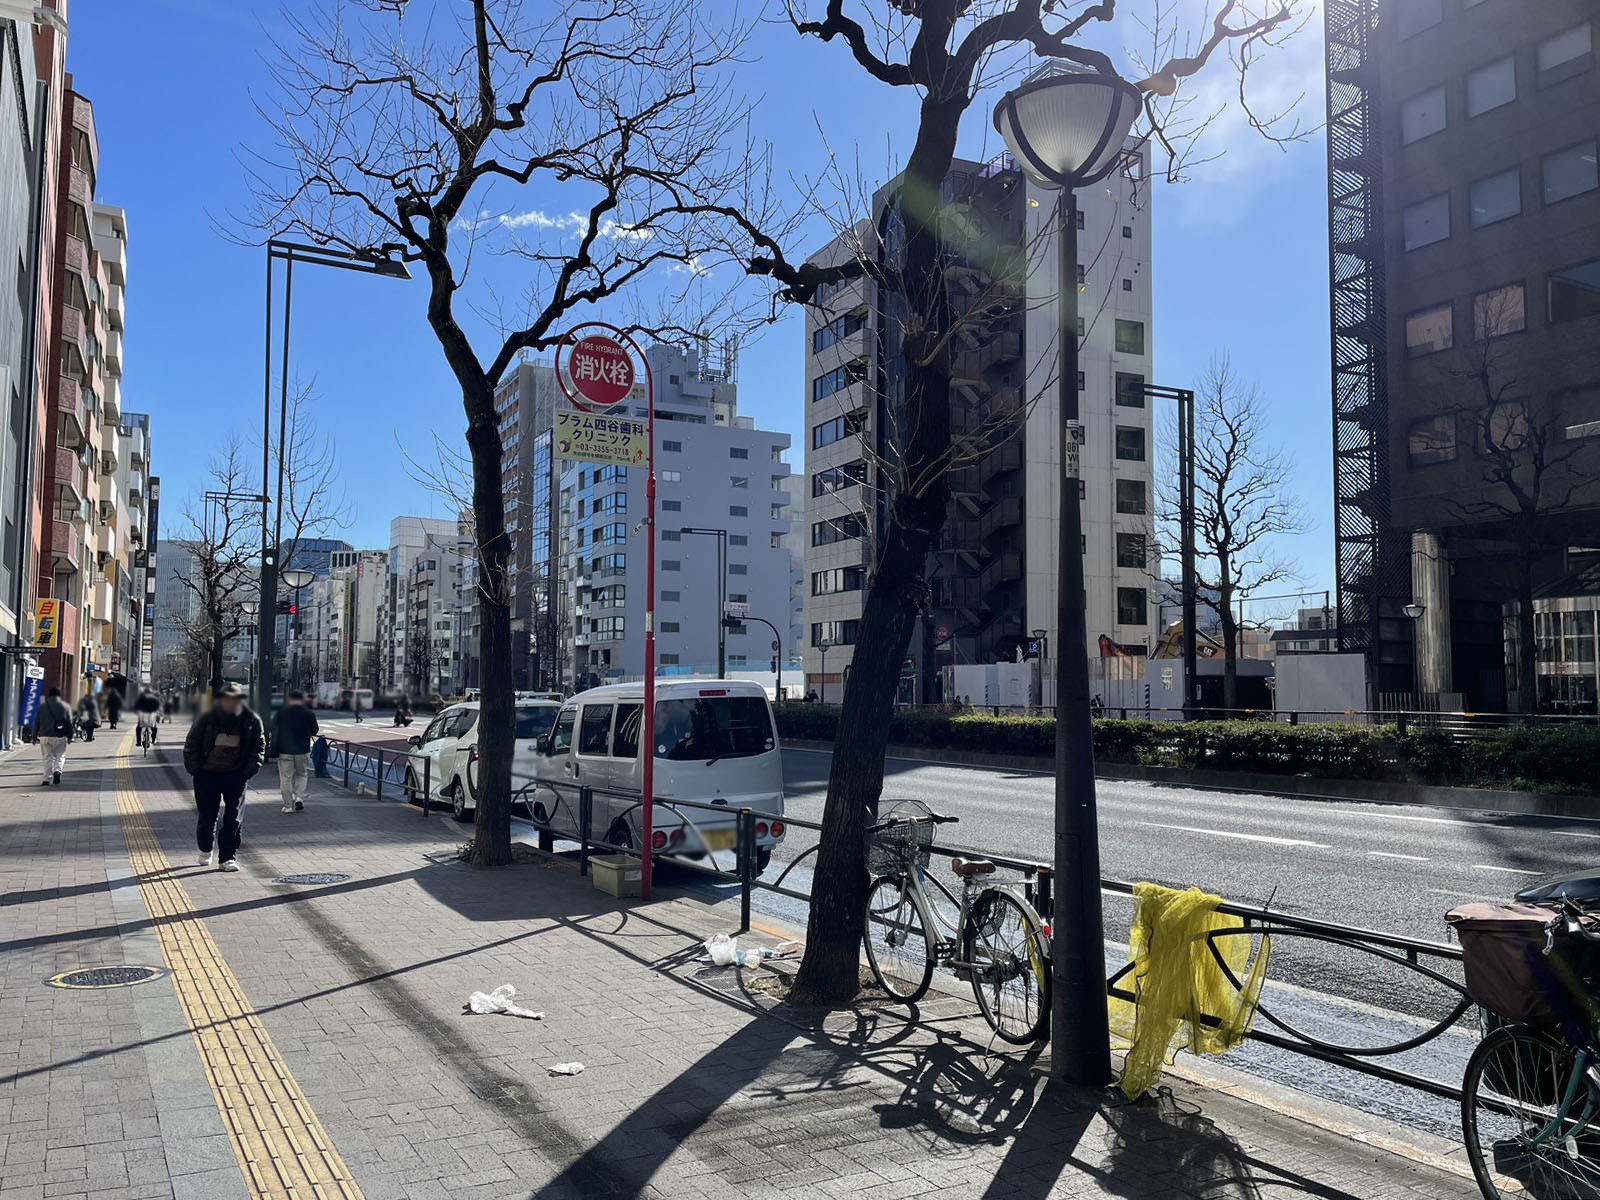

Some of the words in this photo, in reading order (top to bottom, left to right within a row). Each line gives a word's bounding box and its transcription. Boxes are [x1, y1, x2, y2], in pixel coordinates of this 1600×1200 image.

[580, 341, 594, 351] FIRE
[595, 344, 623, 356] HYDRANT
[576, 353, 629, 386] 消火栓
[572, 428, 631, 446] クリニック
[37, 600, 54, 646] 自転車
